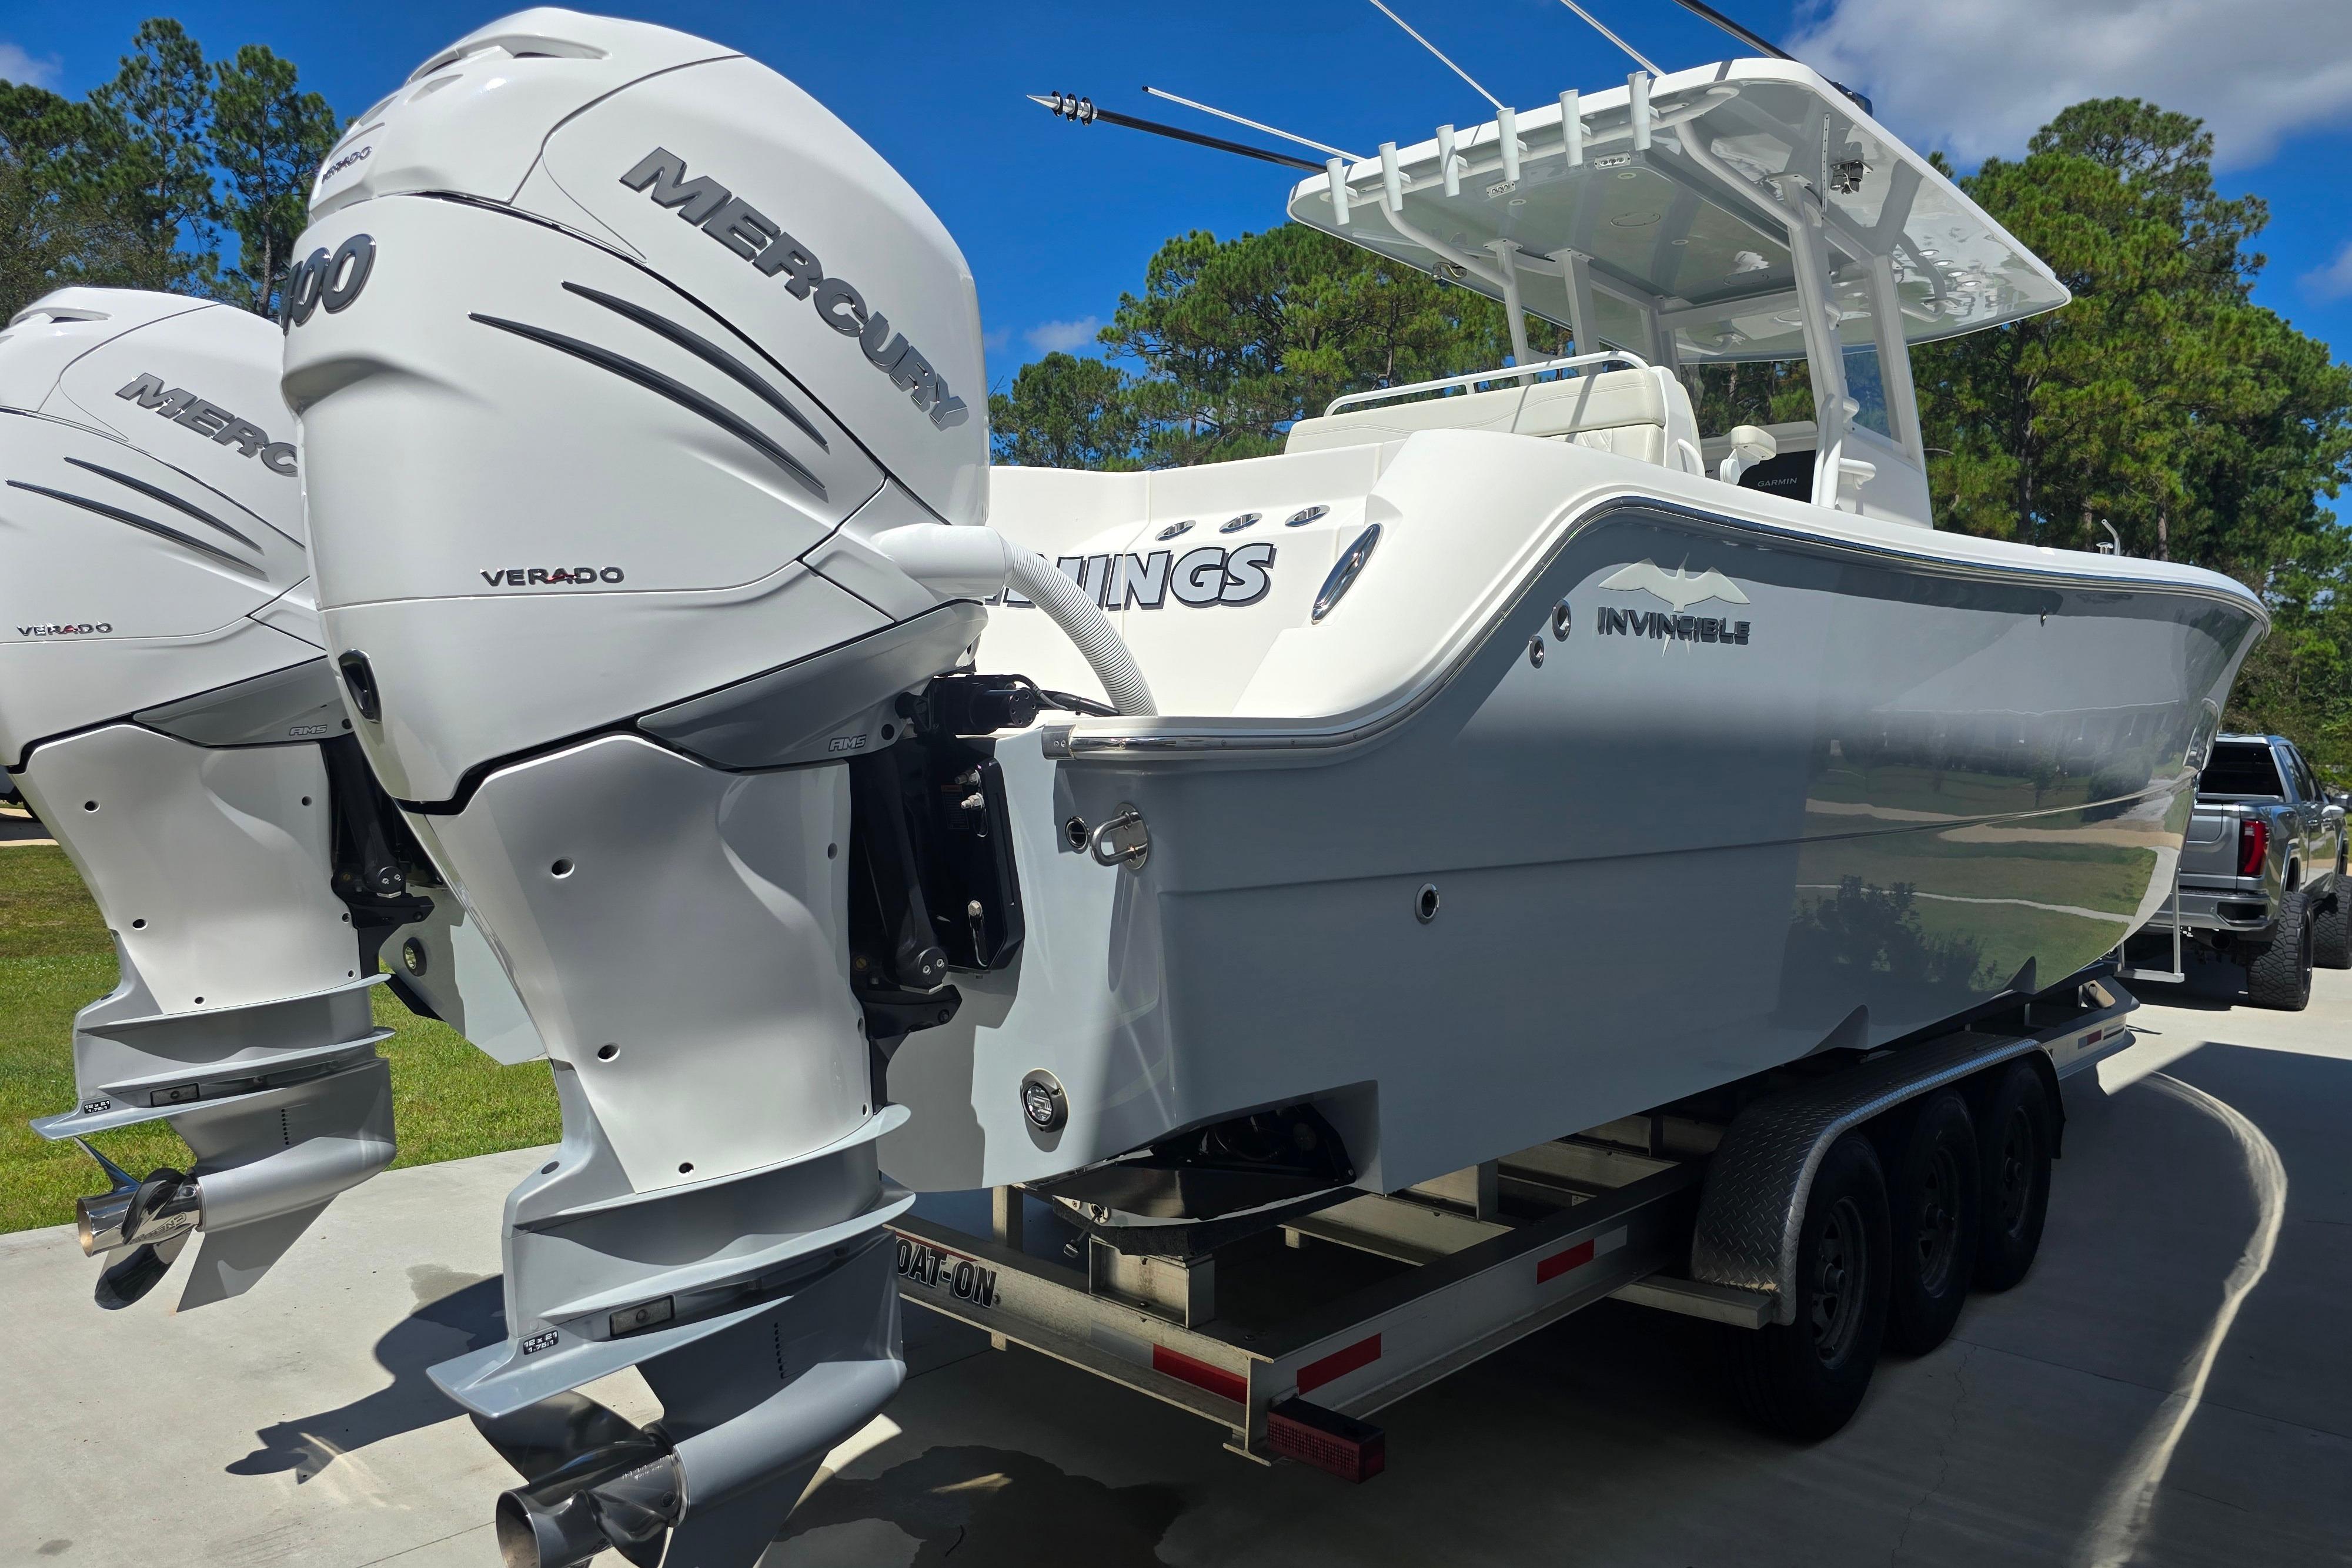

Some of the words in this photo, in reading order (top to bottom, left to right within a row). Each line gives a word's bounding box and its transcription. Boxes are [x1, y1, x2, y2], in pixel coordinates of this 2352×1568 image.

[619, 147, 968, 430] MERCURY
[1758, 477, 1798, 487] GARMIN
[479, 566, 624, 587] VERADO
[17, 621, 113, 636] VERADO
[1598, 606, 1750, 644] INVINCIBLE
[289, 724, 328, 735] AMS
[828, 734, 866, 752] AMS
[524, 1339, 535, 1347] 12
[545, 1331, 557, 1340] 21
[529, 1339, 554, 1352] 1.75:1
